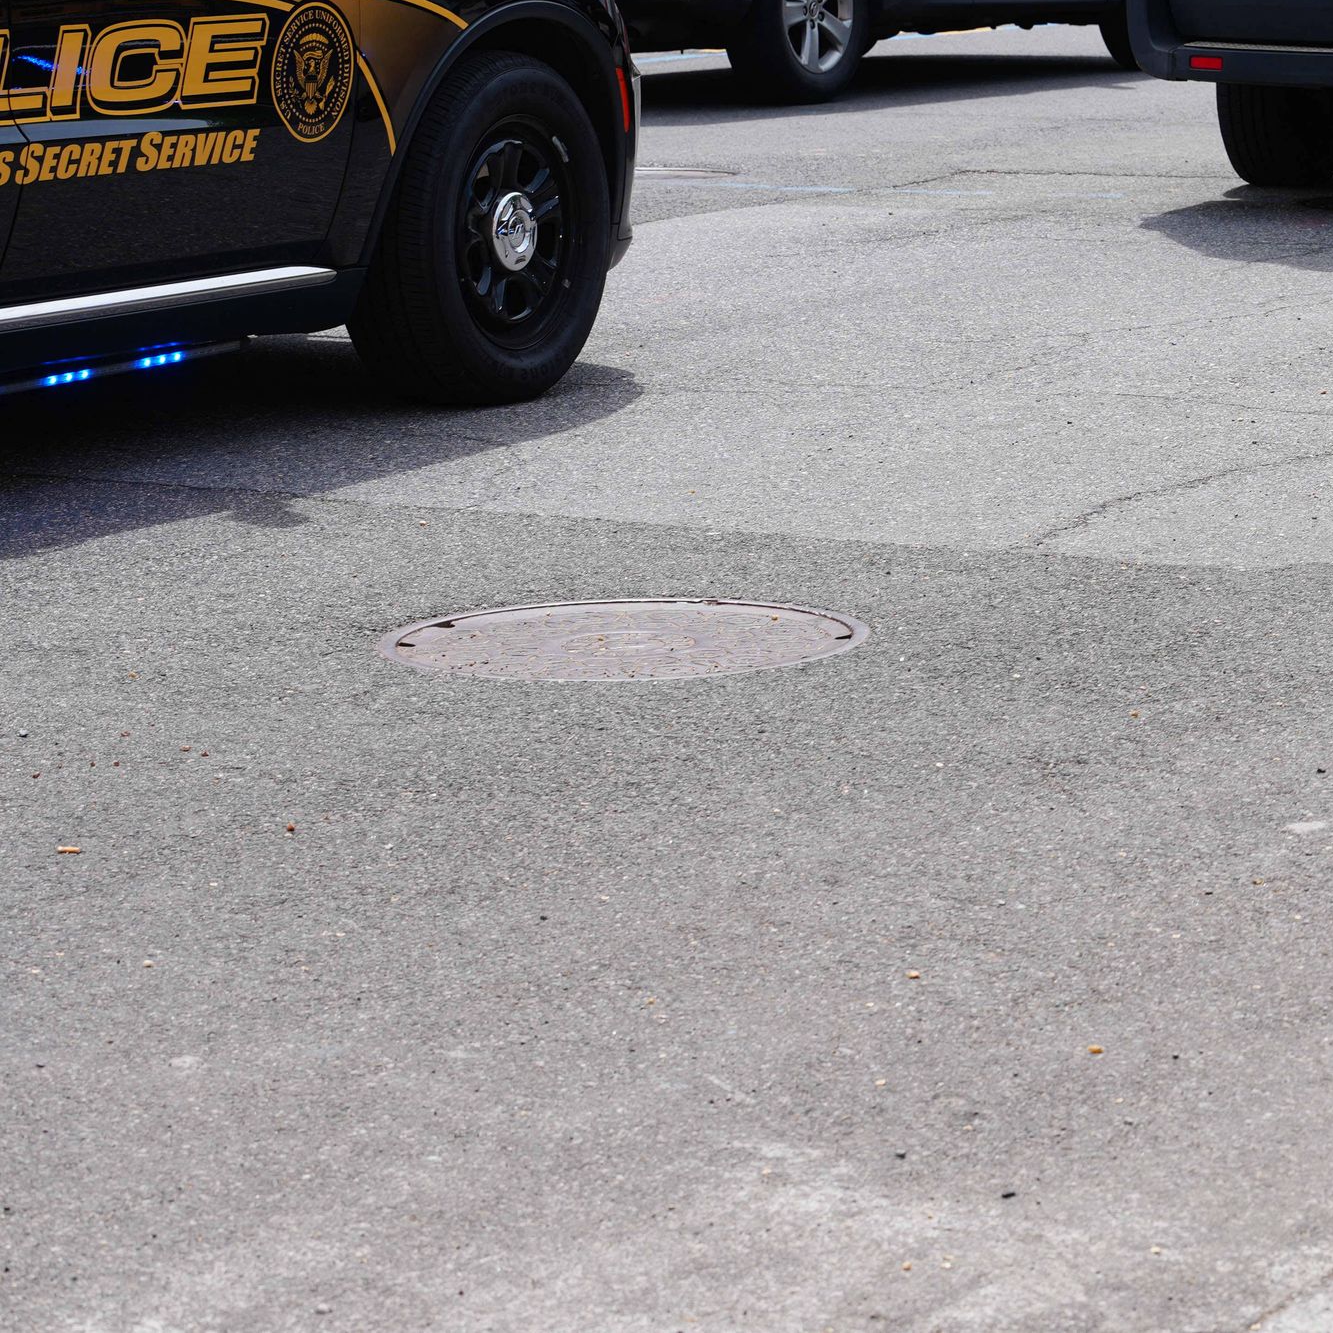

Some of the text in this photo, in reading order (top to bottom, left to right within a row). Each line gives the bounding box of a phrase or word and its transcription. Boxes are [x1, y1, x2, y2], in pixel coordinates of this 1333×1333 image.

[283, 9, 315, 45] SERVICE
[297, 121, 325, 136] POLICE
[15, 140, 138, 185] SECRET
[136, 129, 261, 173] SERVICE
